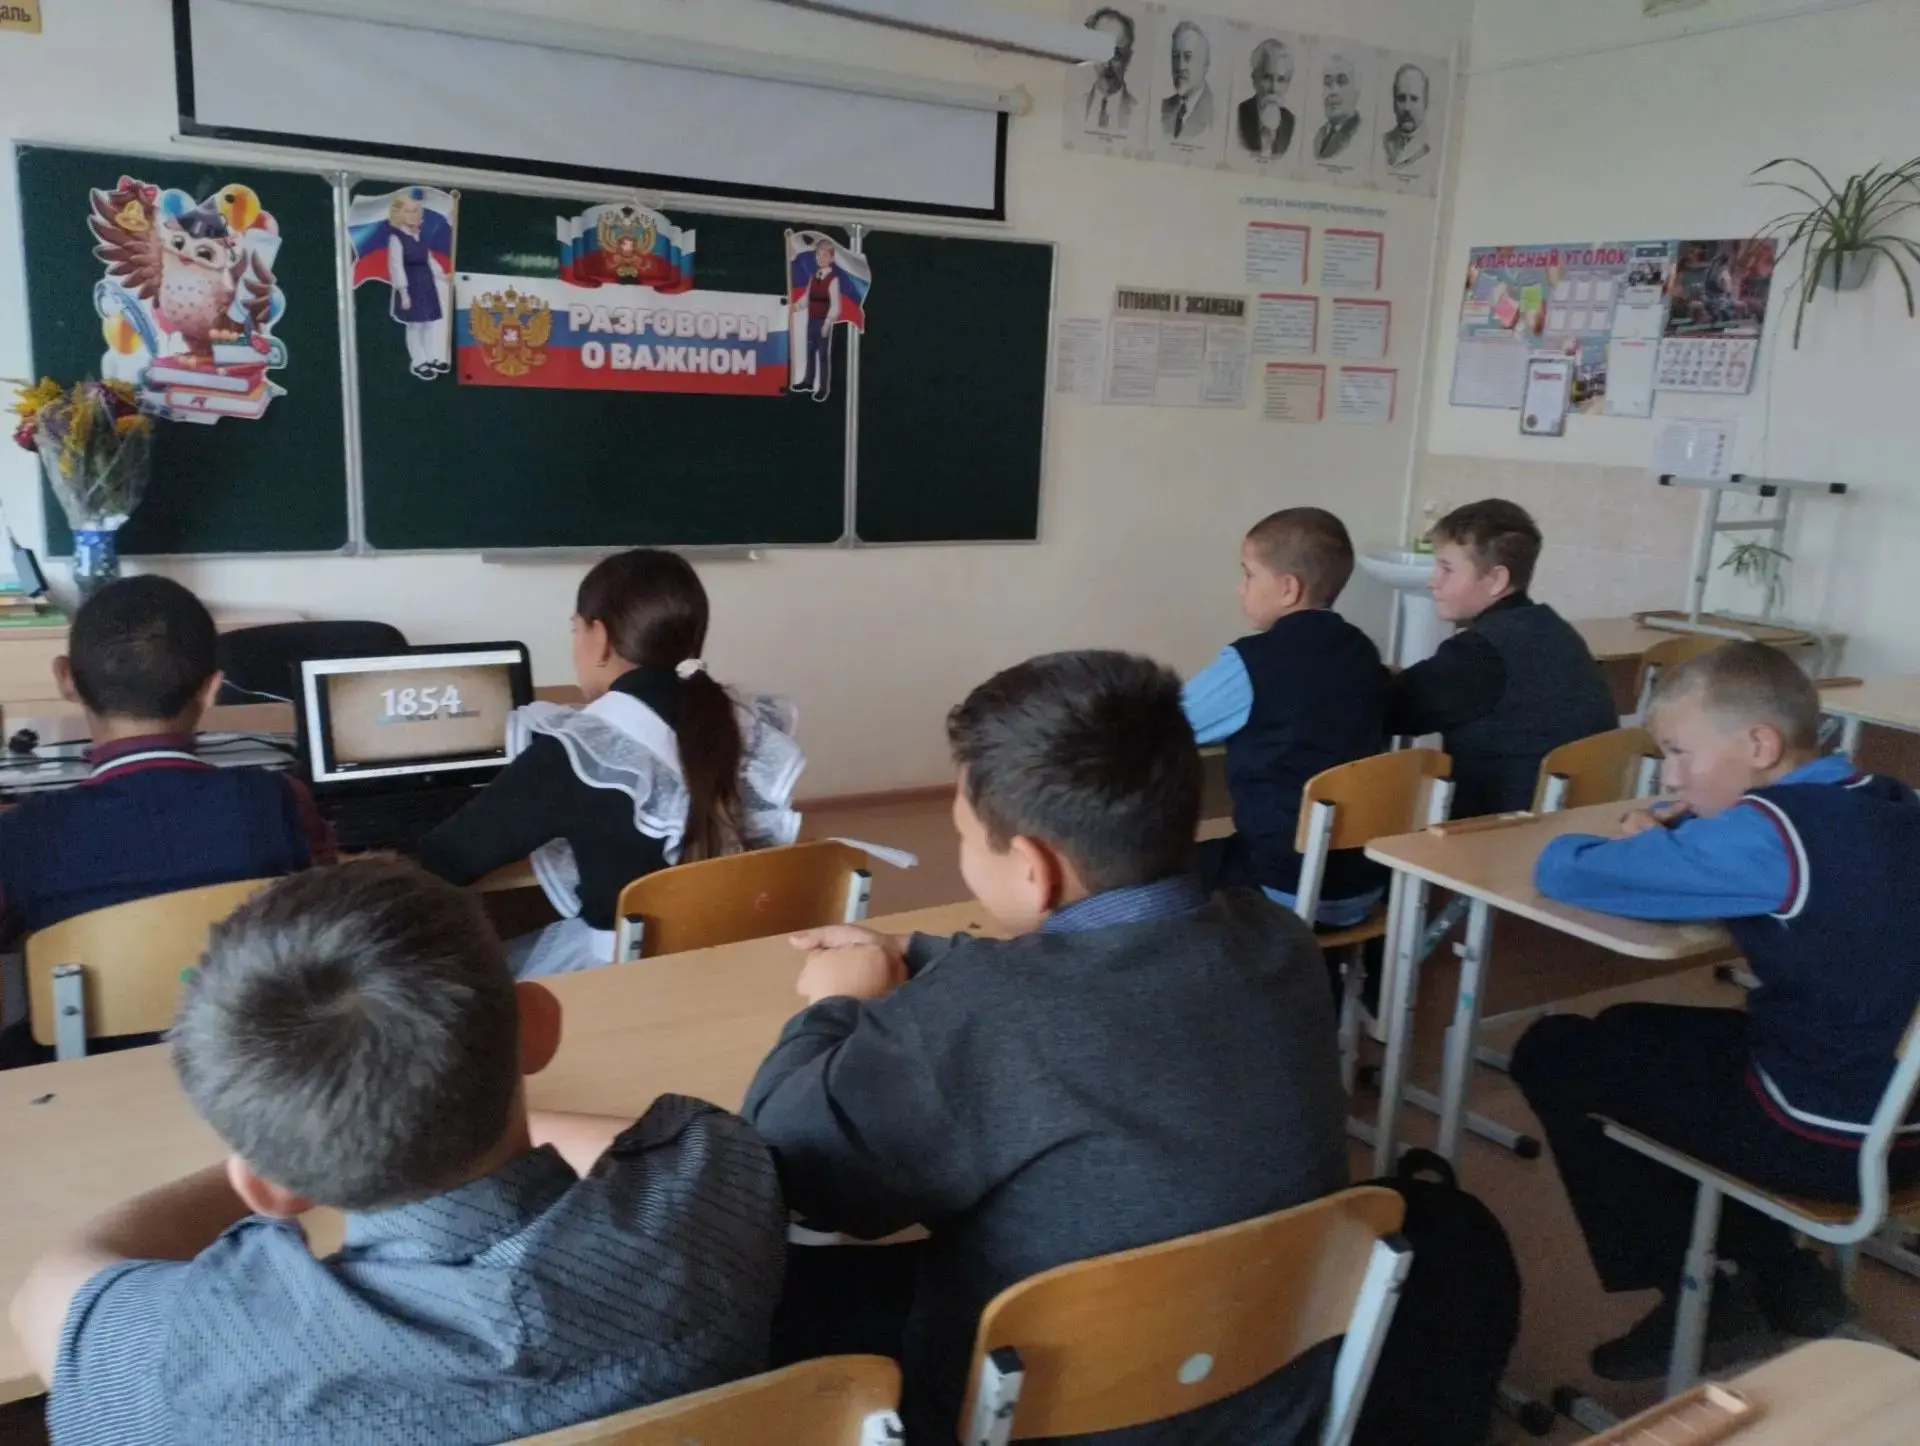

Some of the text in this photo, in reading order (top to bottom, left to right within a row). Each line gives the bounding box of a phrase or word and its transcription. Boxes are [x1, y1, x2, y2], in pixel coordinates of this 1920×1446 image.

[0, 4, 32, 23] аль
[1475, 248, 1627, 269] КЛАССНЫЙ УГОЛОК
[568, 303, 769, 342] РАЗГОВОРЫ
[581, 341, 757, 376] О ВАЖНОМ
[380, 684, 463, 716] 1854
